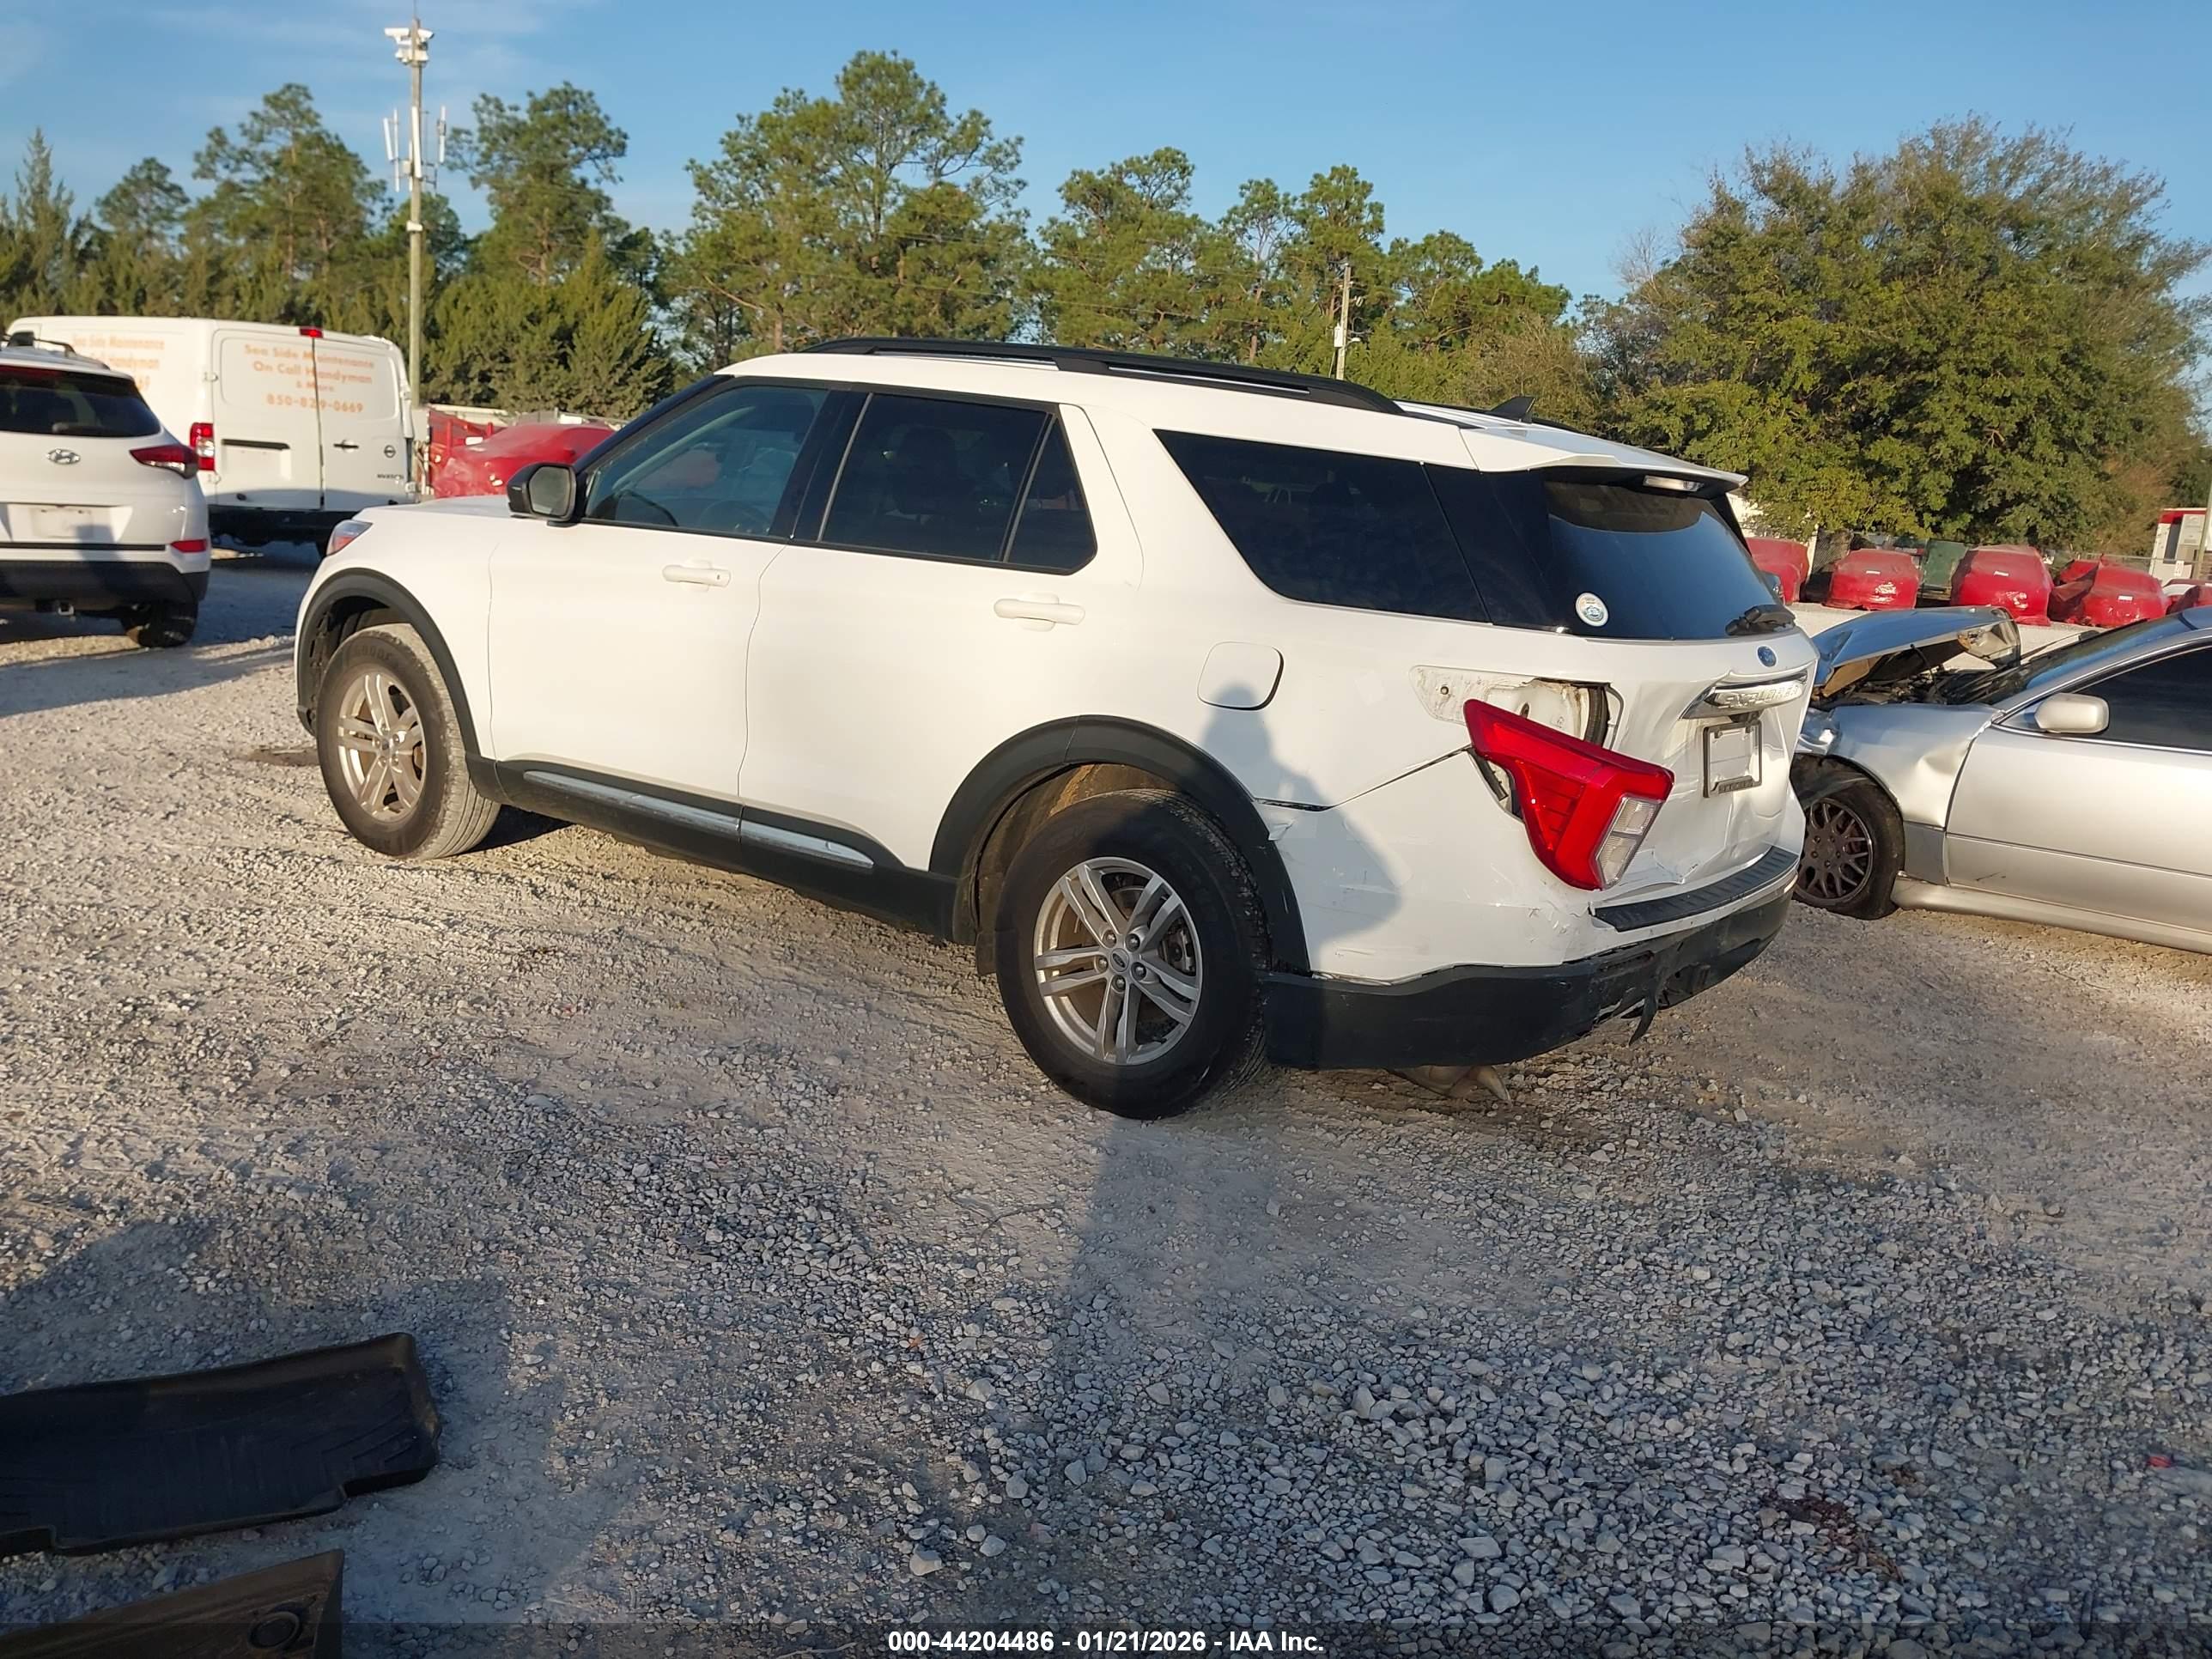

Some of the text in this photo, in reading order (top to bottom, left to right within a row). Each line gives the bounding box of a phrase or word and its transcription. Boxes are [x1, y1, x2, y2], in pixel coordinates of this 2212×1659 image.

[273, 346, 298, 359] Side
[303, 350, 374, 368] Maintenance
[252, 361, 373, 384] On Call Handyman
[1717, 684, 1802, 709] EXPLORER
